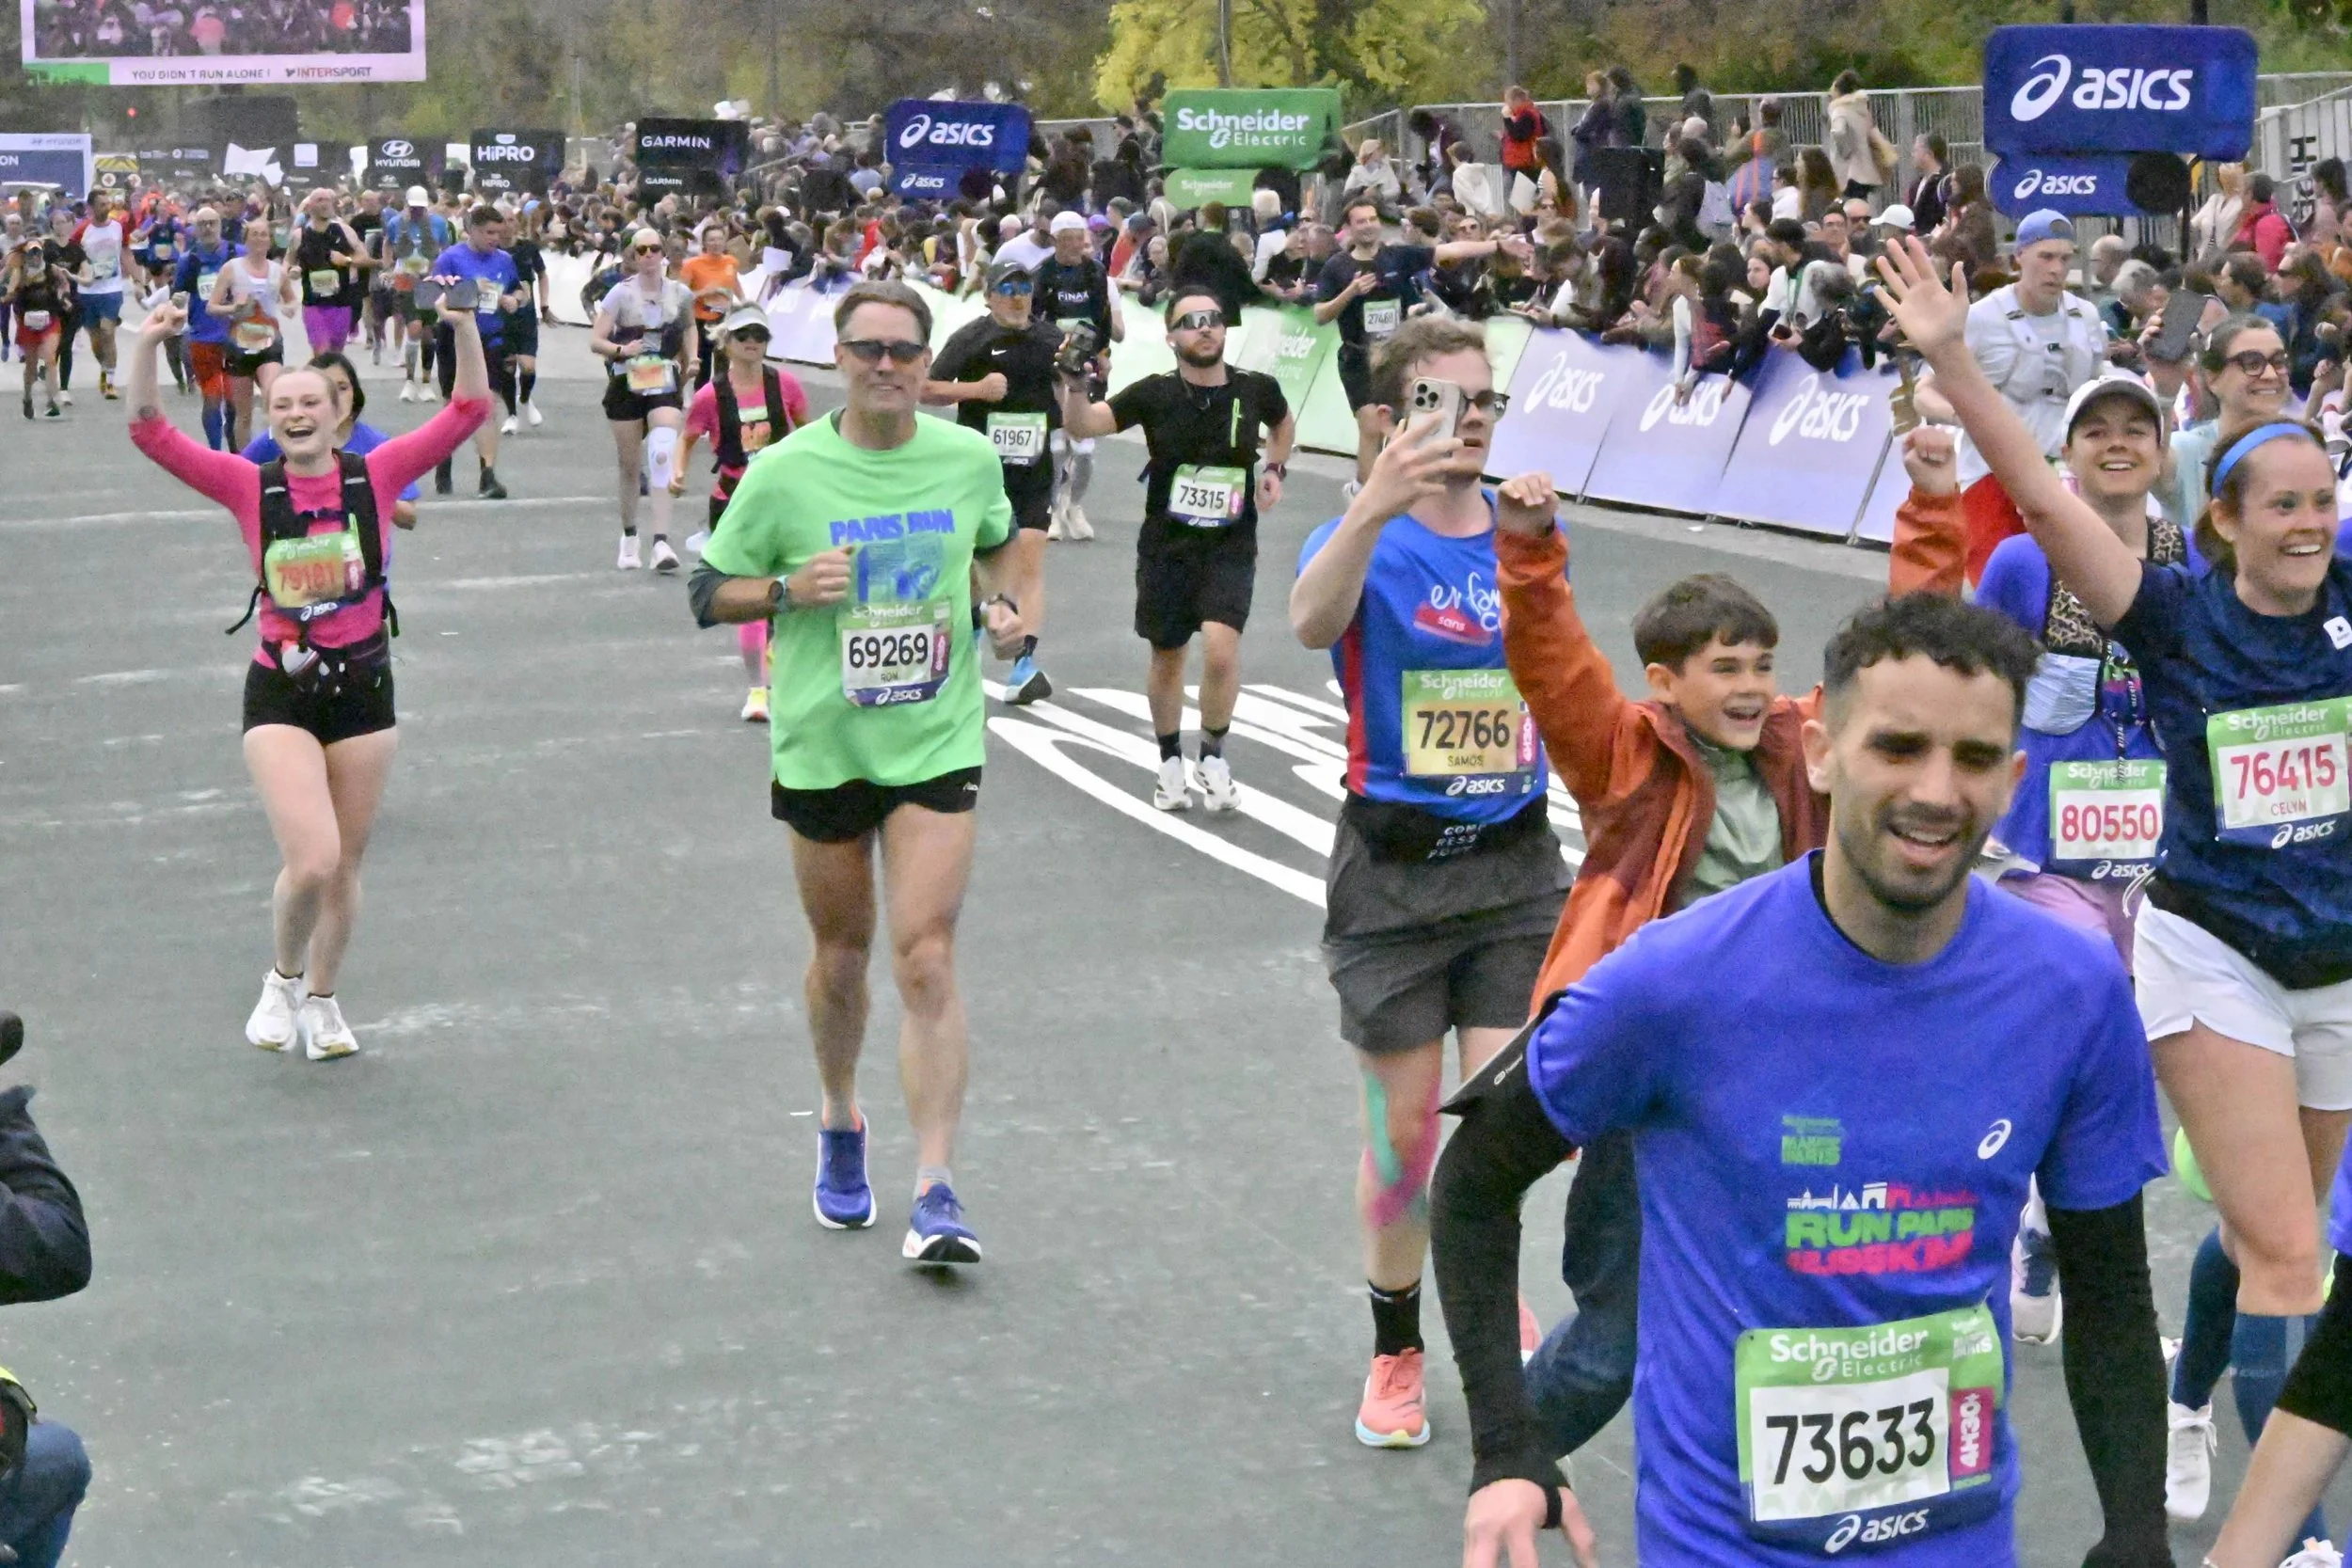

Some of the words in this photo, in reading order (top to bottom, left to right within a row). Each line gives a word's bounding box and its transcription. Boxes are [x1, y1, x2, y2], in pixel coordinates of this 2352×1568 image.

[132, 70, 155, 80] YOU
[199, 70, 223, 79] RUN
[226, 69, 263, 79] ALONE
[296, 67, 373, 78] INTERSPORT
[1177, 107, 1310, 132] Schneider
[642, 135, 710, 149] GARMIN
[1233, 132, 1307, 146] Electric
[477, 146, 534, 162] HiPRO
[375, 159, 421, 167] HYUNDAI
[993, 429, 1032, 446] 61967
[1180, 484, 1225, 509] 73315
[852, 604, 923, 620] Schneider
[1438, 616, 1466, 631] sans
[849, 632, 929, 669] 69269
[1421, 673, 1506, 689] Schneider
[2226, 706, 2329, 731] Schneider
[1417, 709, 1510, 750] 72766
[1447, 755, 1485, 767] SAMOS
[2230, 744, 2336, 800] 76415
[2270, 800, 2308, 816] CELYN
[2061, 803, 2158, 842] 80550
[1786, 1210, 1891, 1249] RUN
[1770, 1328, 1930, 1362] Schneider
[1843, 1354, 1923, 1377] Electric
[1766, 1397, 1936, 1485] 73633
